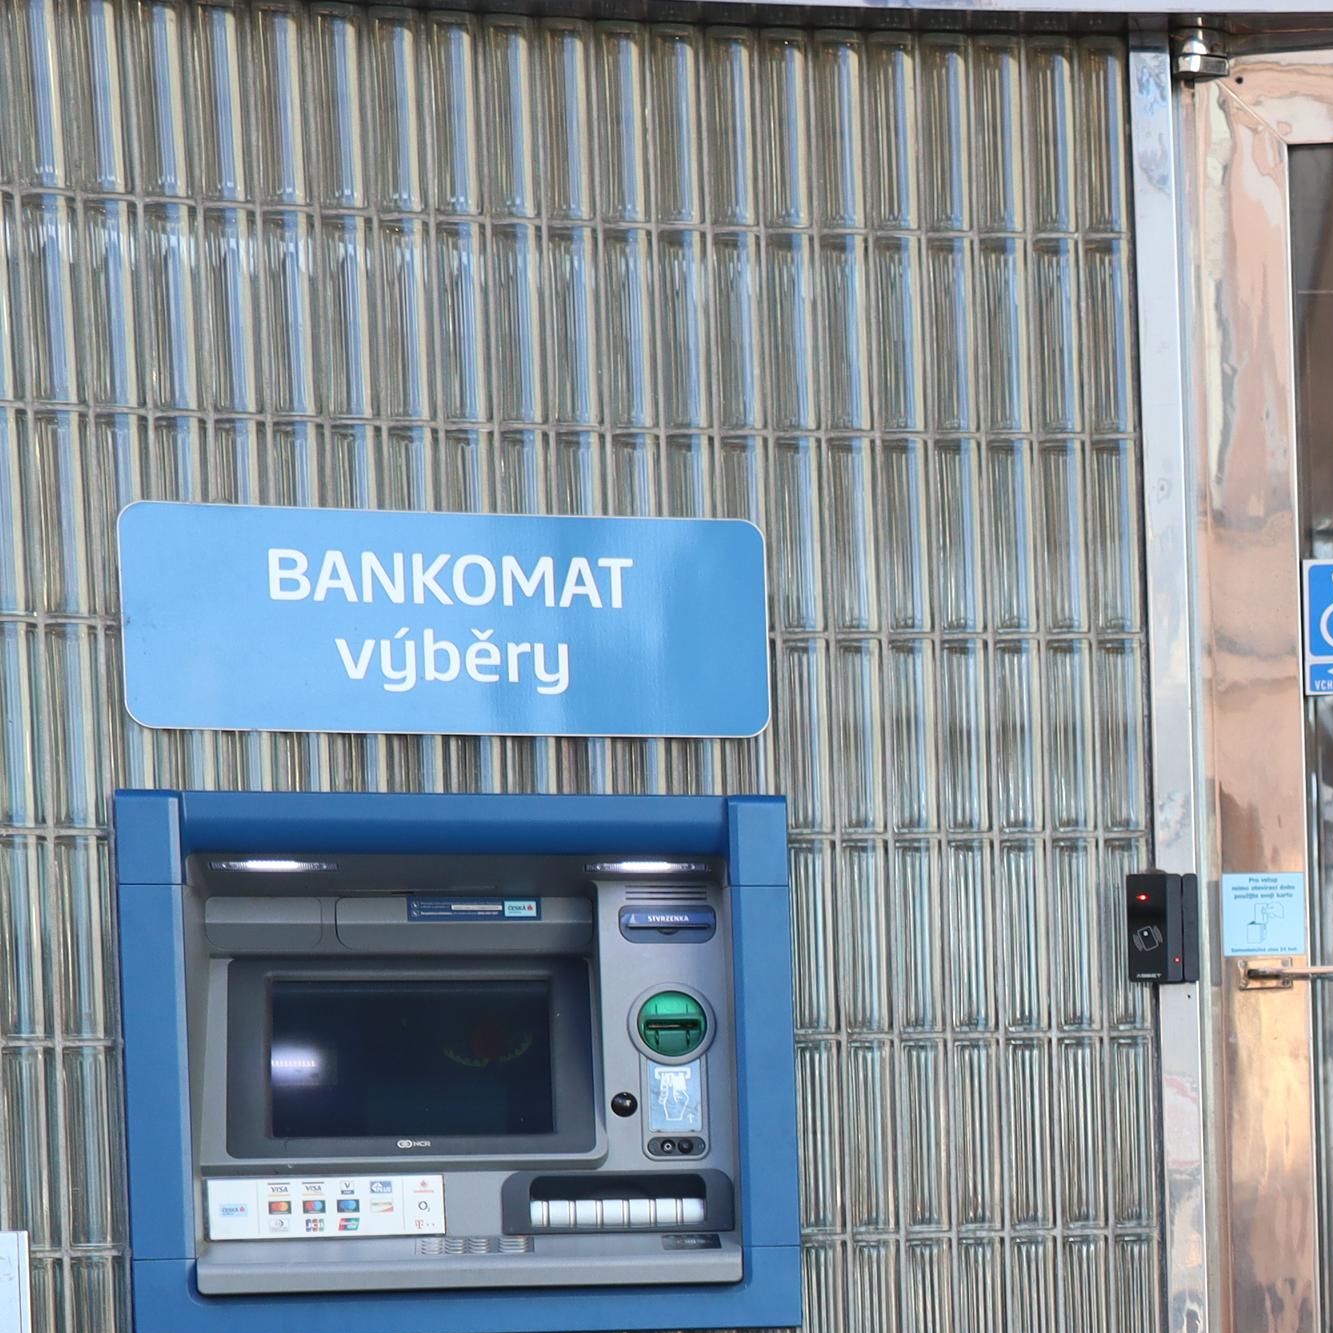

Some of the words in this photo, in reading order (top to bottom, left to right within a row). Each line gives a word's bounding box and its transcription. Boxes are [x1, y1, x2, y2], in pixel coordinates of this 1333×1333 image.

[267, 547, 634, 609] BANKOMAT
[334, 626, 570, 695] výběry
[270, 1185, 289, 1193] VISA
[304, 1184, 322, 1192] VISA
